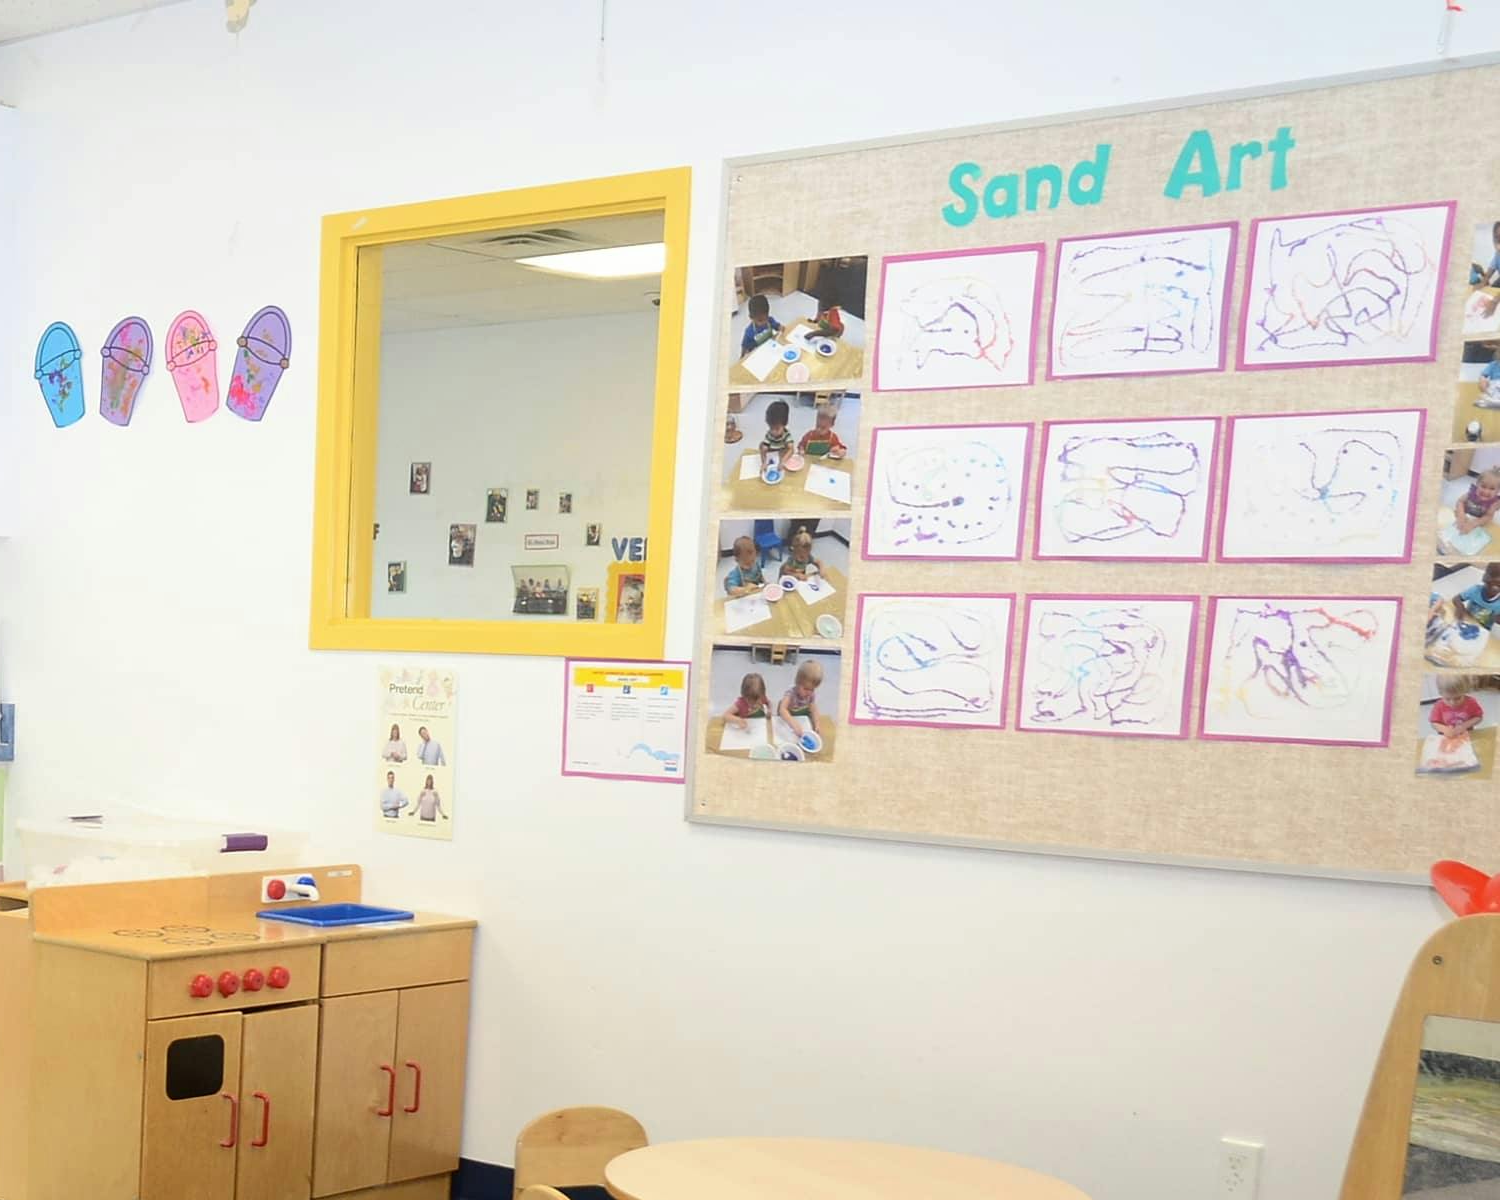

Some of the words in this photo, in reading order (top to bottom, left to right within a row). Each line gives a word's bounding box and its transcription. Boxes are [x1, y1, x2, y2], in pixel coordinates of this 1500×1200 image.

[941, 143, 1113, 227] Sand
[1163, 126, 1296, 200] Art
[389, 683, 424, 695] Pretend
[412, 697, 446, 711] Center
